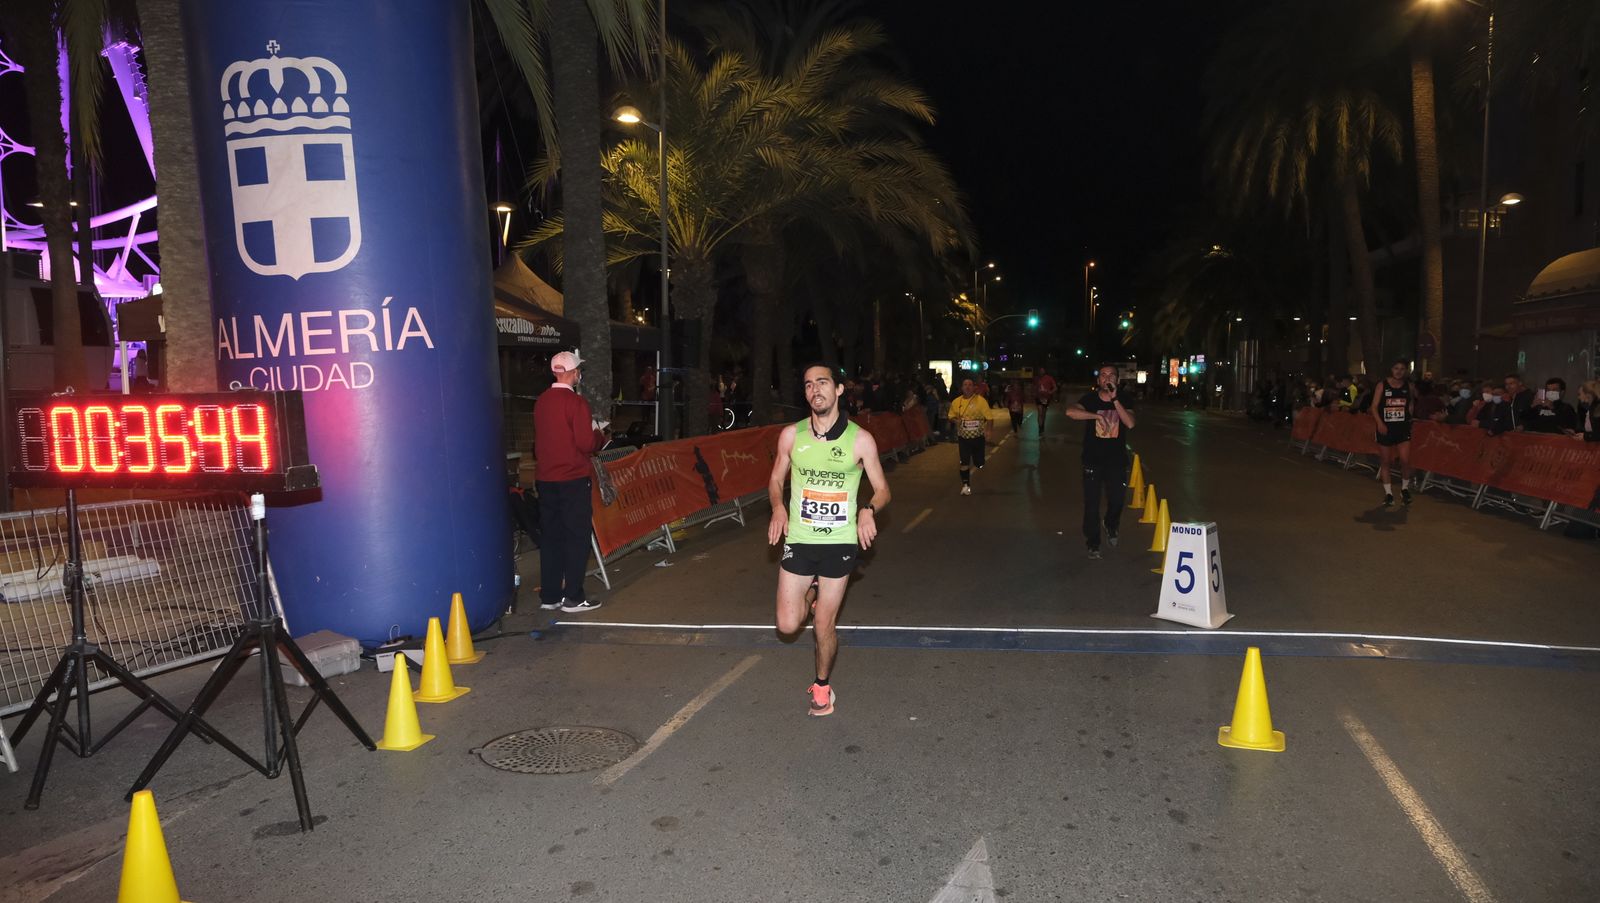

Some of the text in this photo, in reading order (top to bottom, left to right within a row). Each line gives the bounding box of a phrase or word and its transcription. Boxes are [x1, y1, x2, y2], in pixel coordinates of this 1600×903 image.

[218, 296, 435, 361] ALMERÍA
[249, 362, 374, 391] CIUDAD
[799, 468, 845, 479] Universo
[806, 478, 844, 488] Running
[809, 502, 840, 515] 350
[1172, 526, 1202, 535] MONDO
[1175, 552, 1195, 594] 5
[1210, 550, 1220, 593] 5
